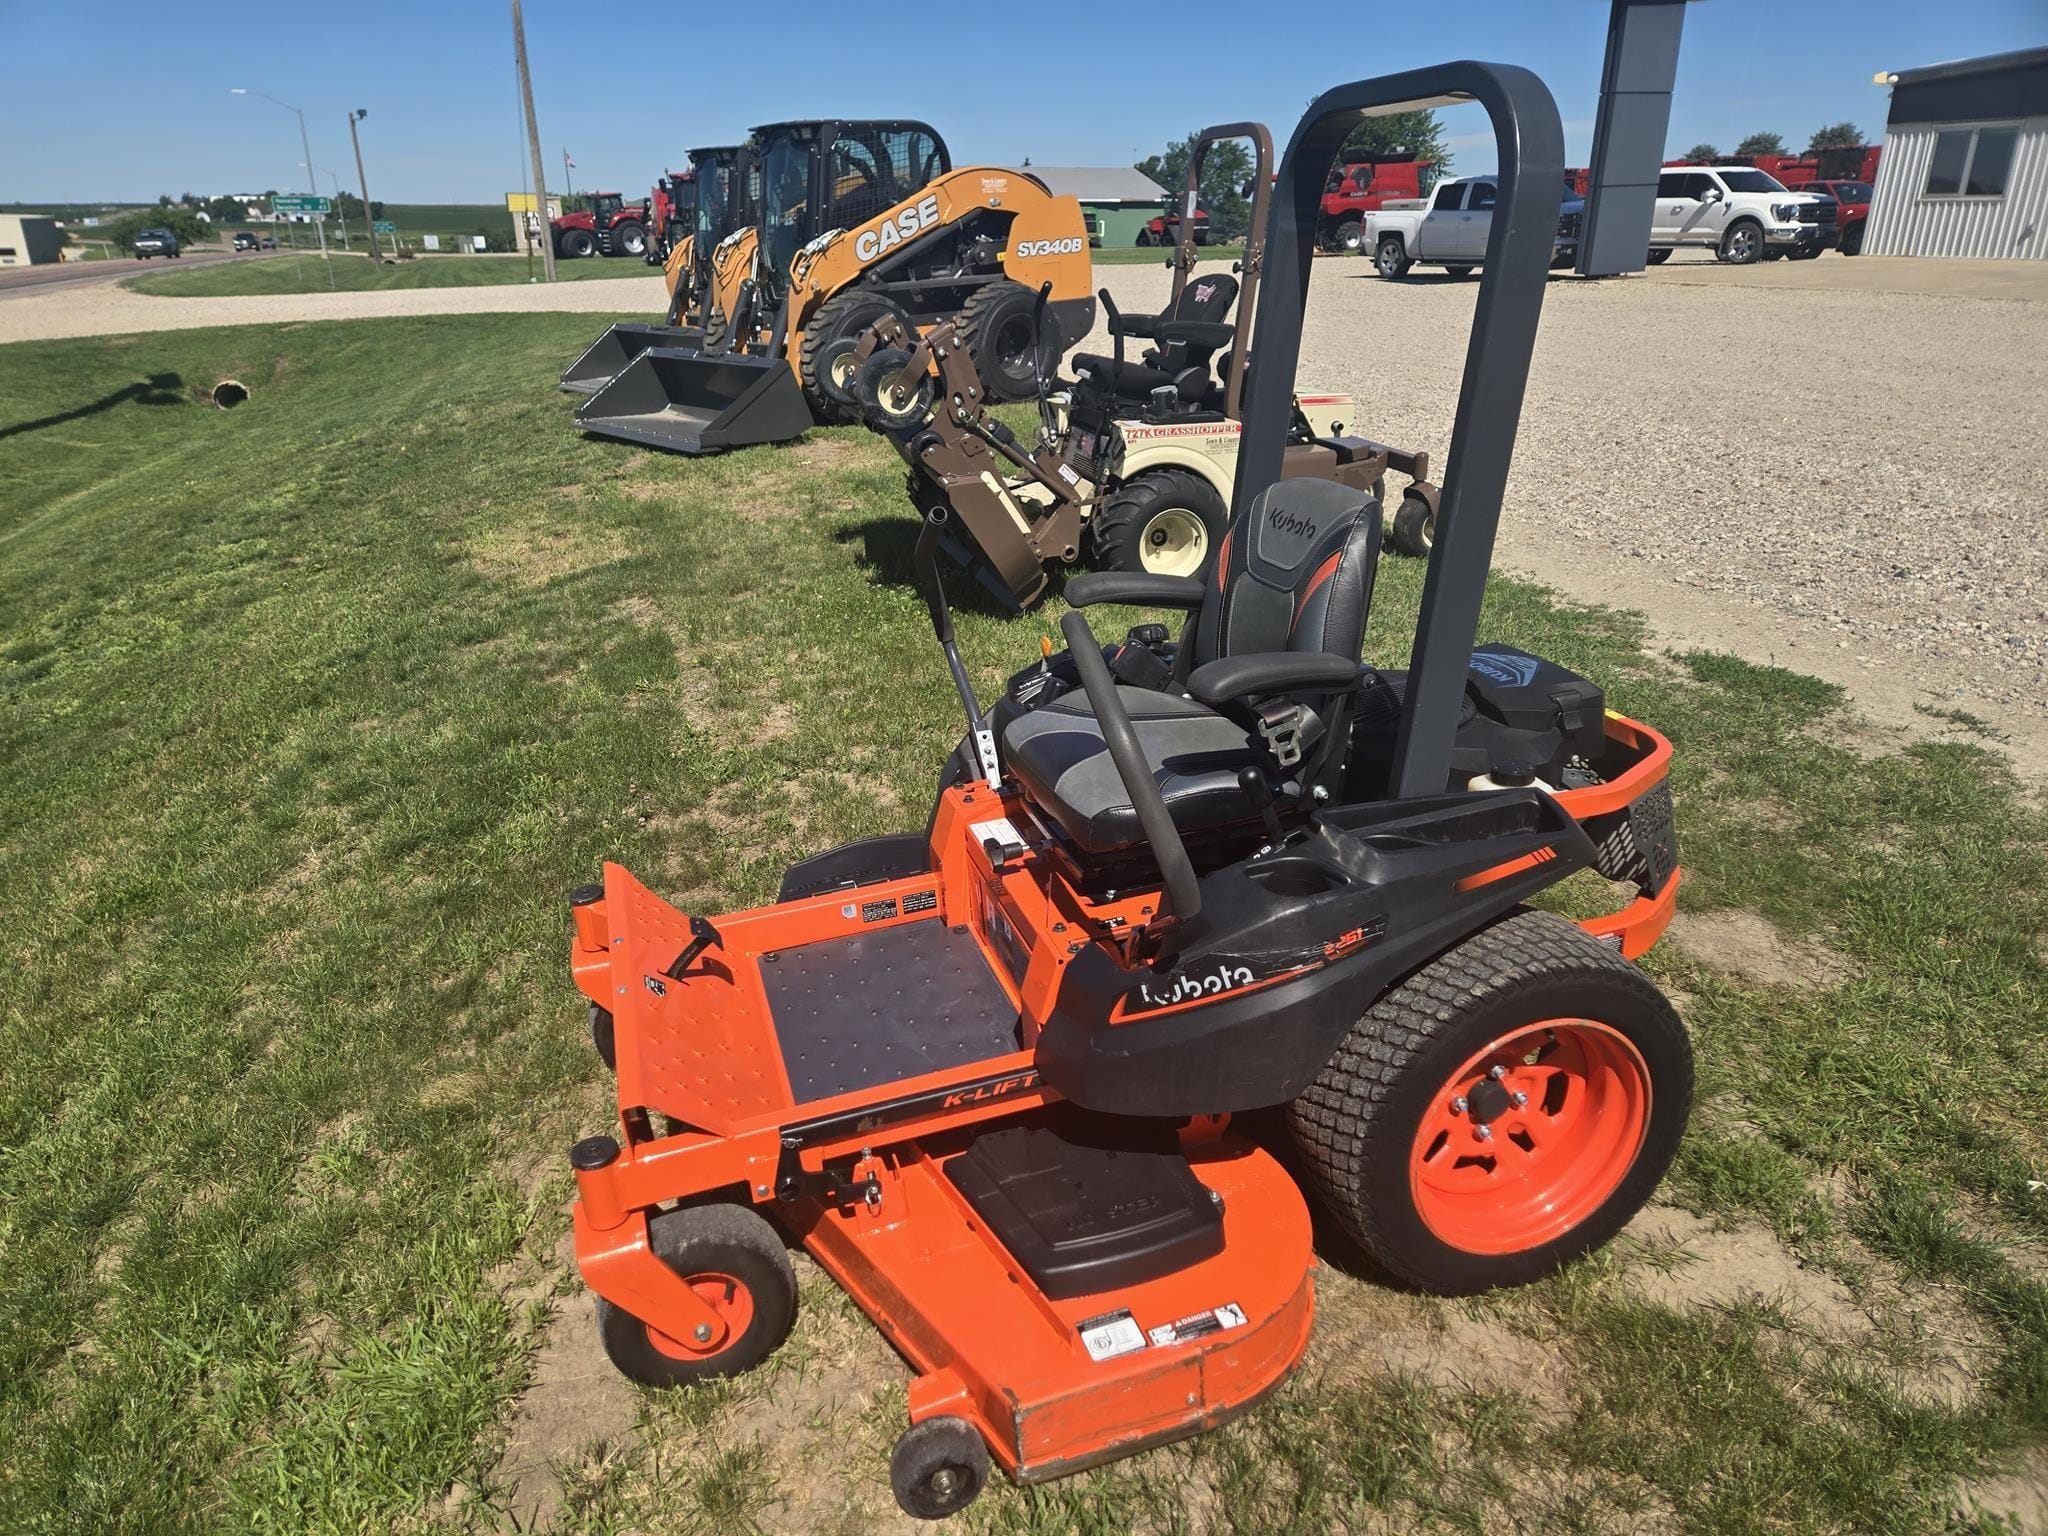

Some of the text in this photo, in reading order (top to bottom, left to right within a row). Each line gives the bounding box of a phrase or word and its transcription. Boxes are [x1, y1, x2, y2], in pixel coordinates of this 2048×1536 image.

[855, 192, 940, 262] CASE
[1017, 238, 1083, 258] SV340B
[1125, 425, 1237, 439] 727K GRASSHOPPER
[1269, 507, 1316, 539] Kubota
[1470, 662, 1514, 682] KUBO
[943, 1074, 1034, 1108] K-LIFT
[1181, 1310, 1212, 1324] DANGER
